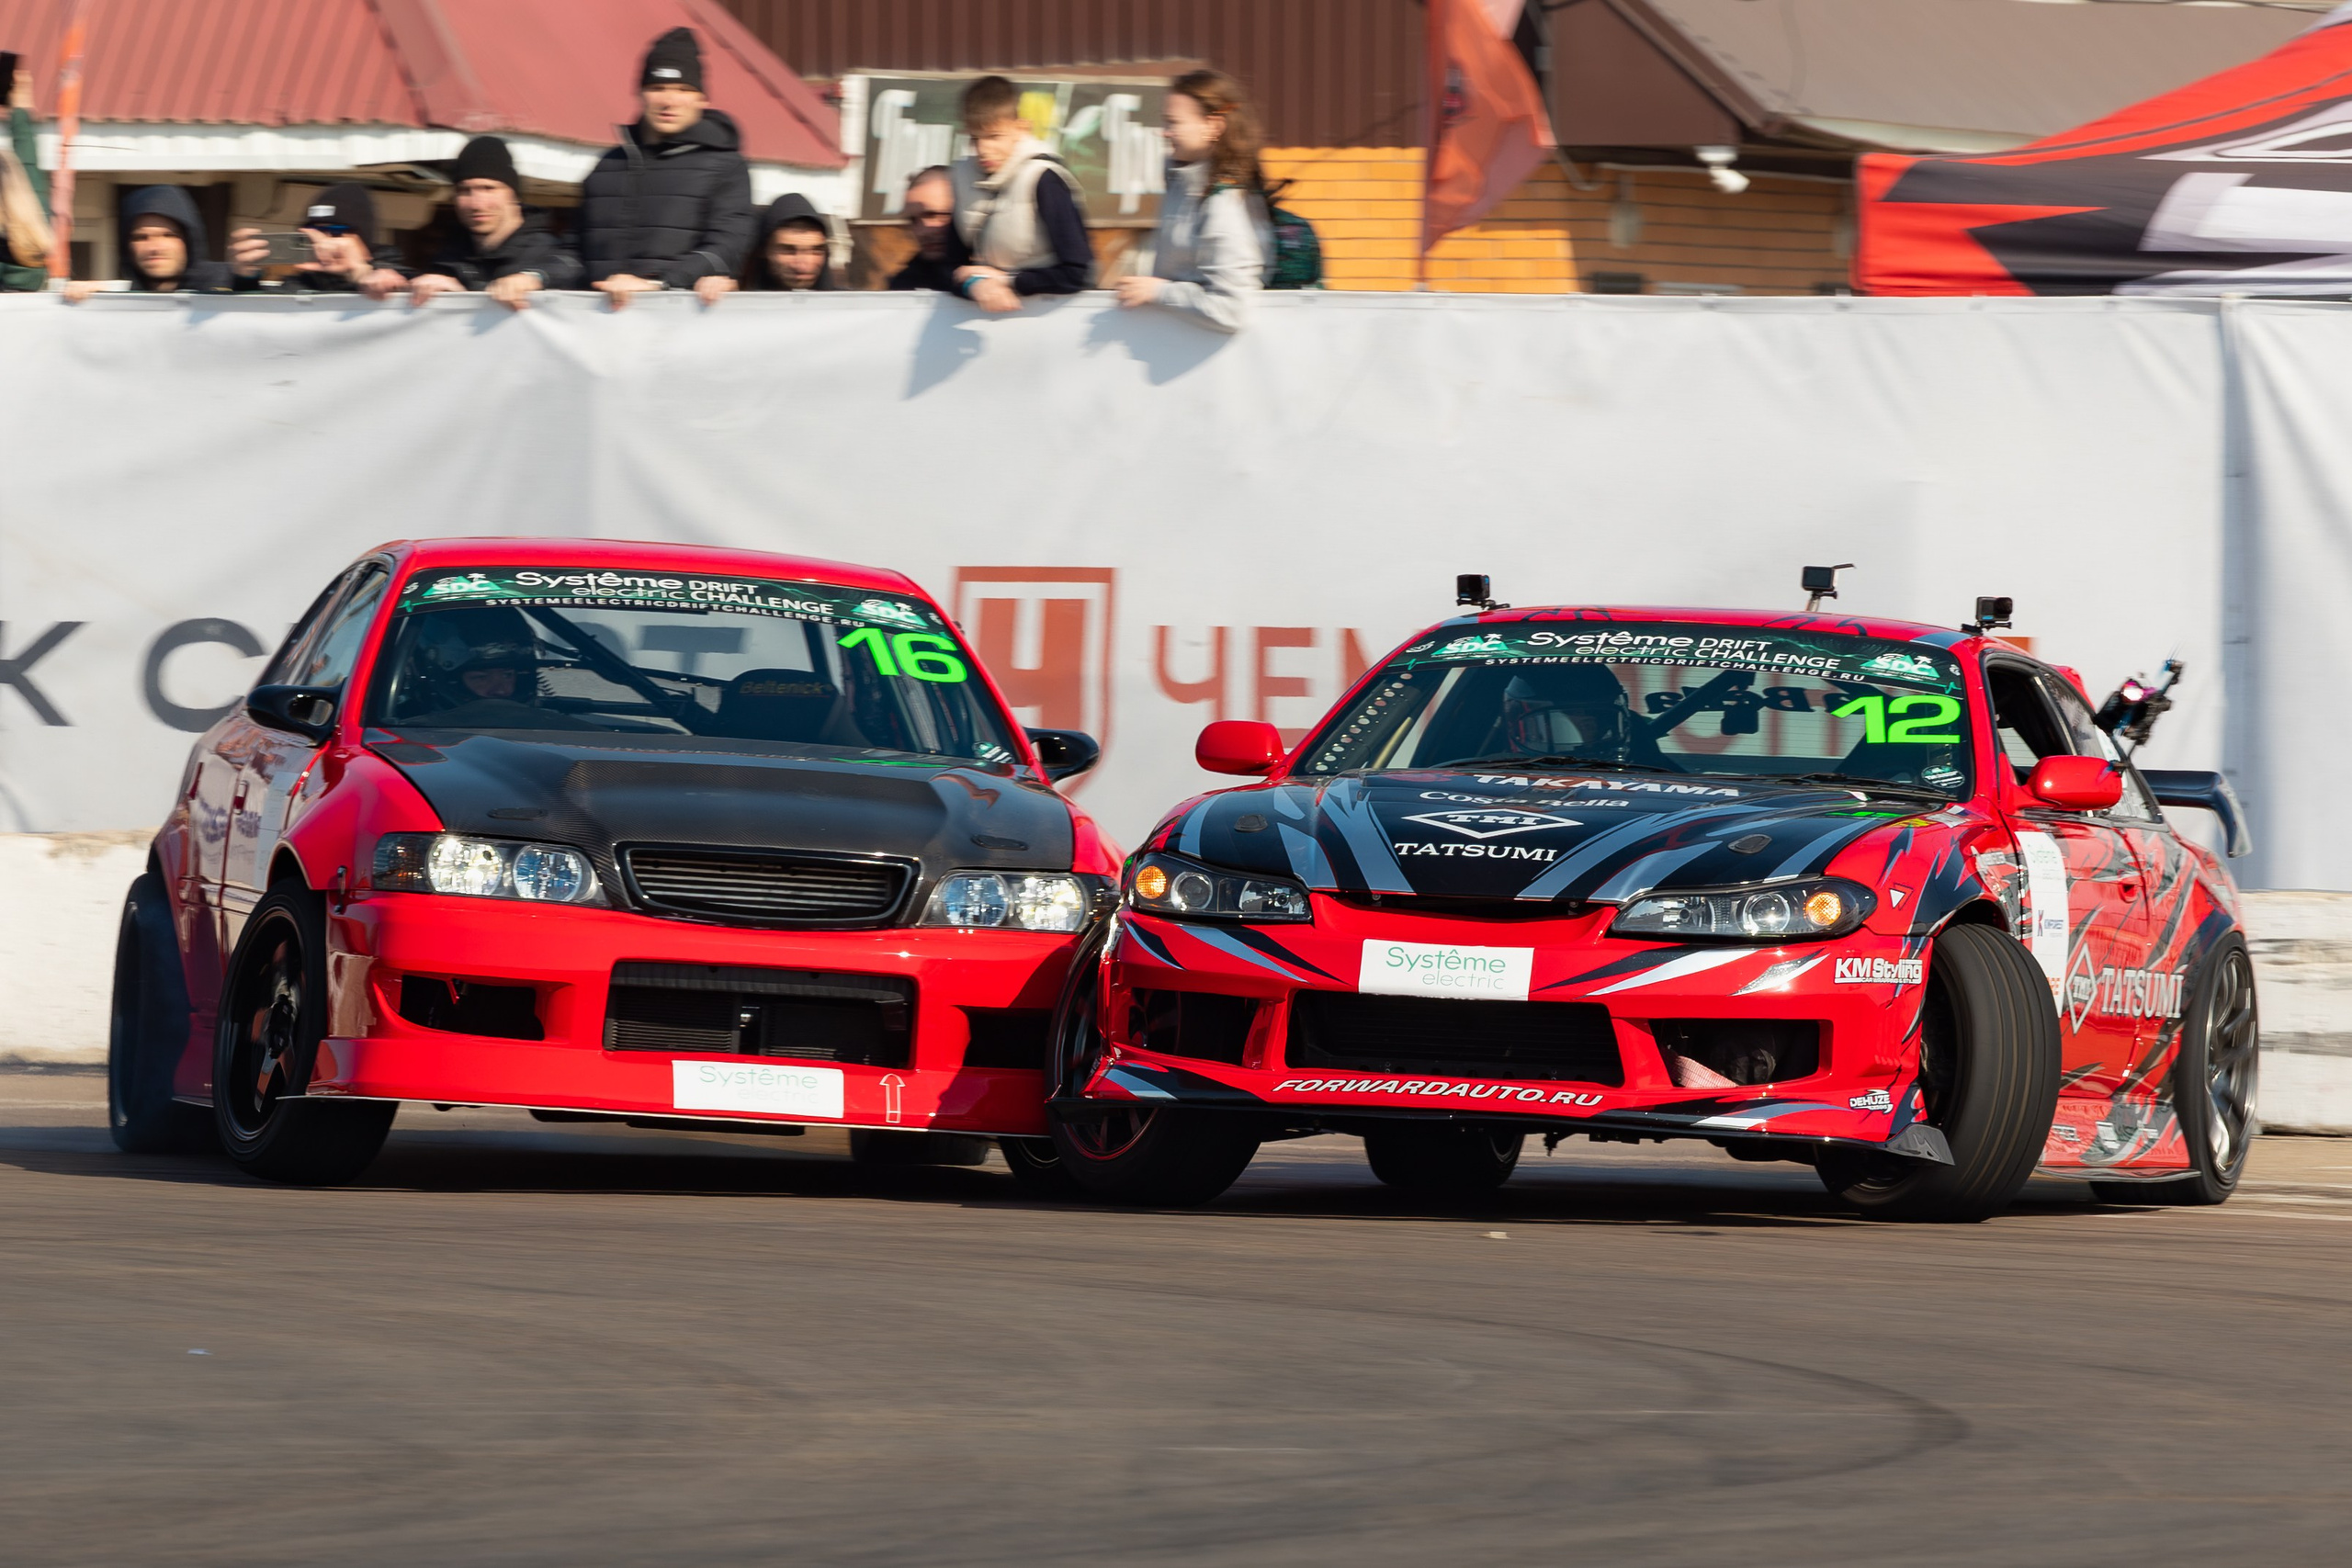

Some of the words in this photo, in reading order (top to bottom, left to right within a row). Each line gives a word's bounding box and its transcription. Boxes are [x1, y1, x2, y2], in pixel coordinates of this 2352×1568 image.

[514, 571, 684, 589] Système
[689, 580, 758, 594] DRIFT
[571, 585, 685, 600] electric
[691, 590, 833, 615] CHALLENGE
[1446, 641, 1498, 654] SDC
[1527, 631, 1694, 648] Système
[1699, 637, 1772, 651] DRIFT
[837, 628, 967, 683] 16
[1575, 644, 1689, 657] electric
[1694, 648, 1841, 670] CHALLENGE
[1872, 658, 1933, 676] SDC
[1485, 656, 1865, 682] SYSTEMEELECTRICDRIFTCHALLENGE.RU
[1830, 695, 1961, 744] 12
[1472, 773, 1740, 797] TAKAYAMA
[1446, 813, 1542, 826] TMI
[1394, 842, 1558, 863] TATSUMI
[1385, 946, 1506, 974] Système
[1421, 970, 1505, 990] electric
[2101, 967, 2185, 1019] TATSUMI
[698, 1065, 819, 1089] Système
[1272, 1078, 1604, 1107] FORWARDAUTO.RU
[1849, 1094, 1891, 1108] DEHUZE
